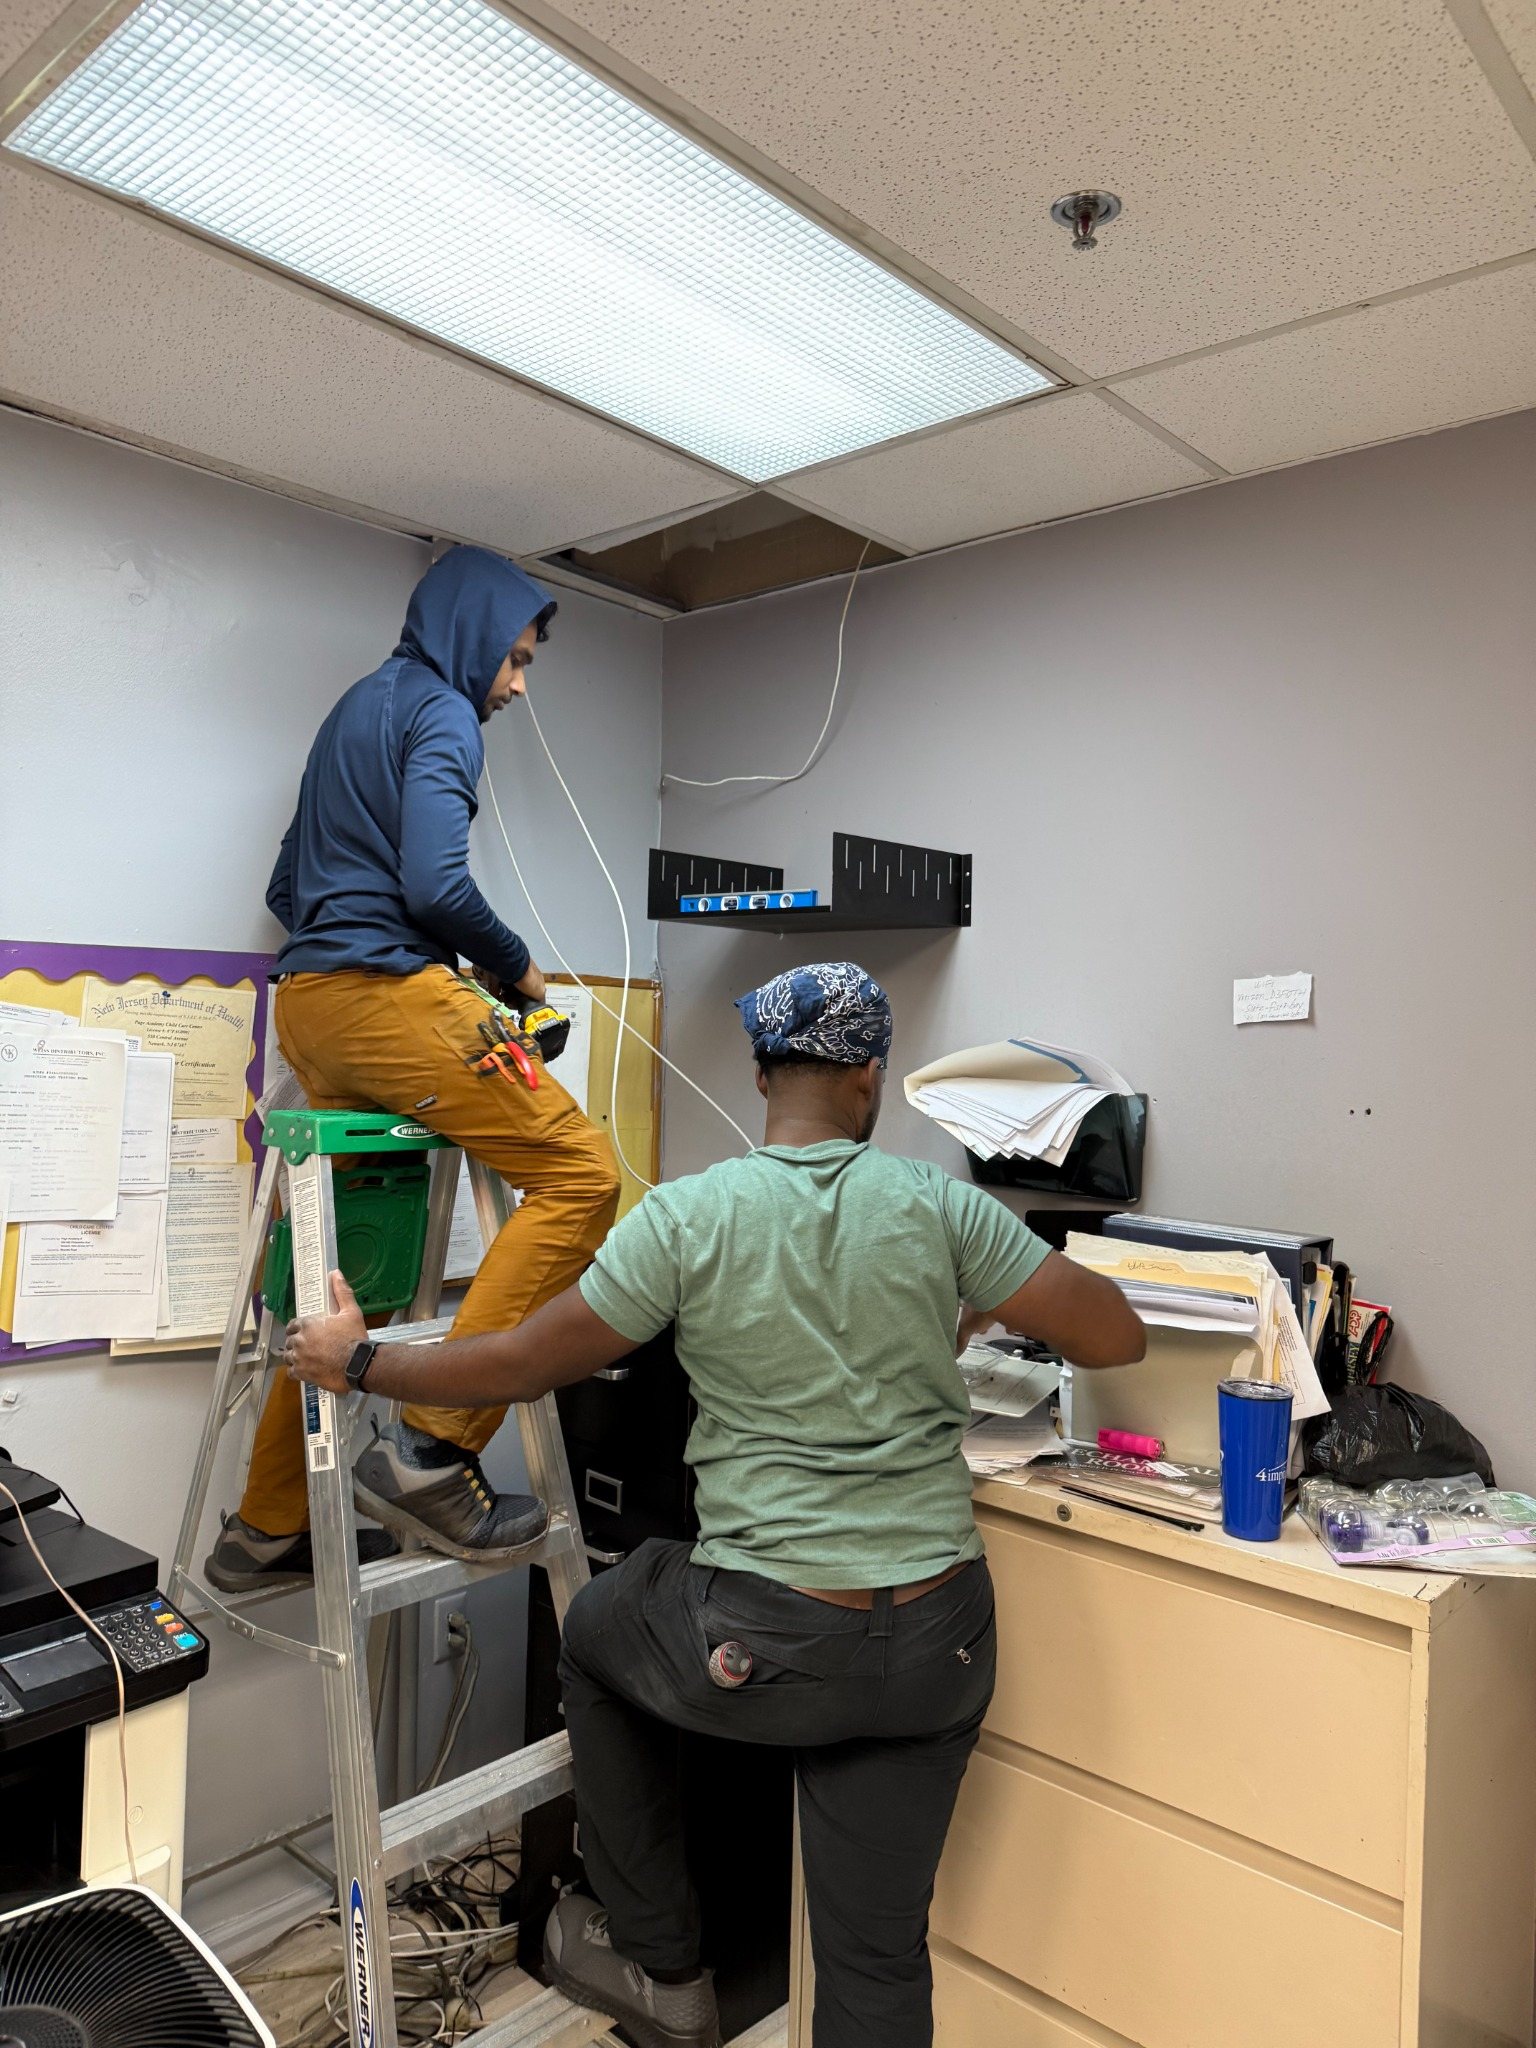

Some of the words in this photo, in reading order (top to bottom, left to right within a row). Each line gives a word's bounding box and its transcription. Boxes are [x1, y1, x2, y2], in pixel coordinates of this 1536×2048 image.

[91, 1001, 115, 1023] New
[118, 997, 148, 1012] Jersey
[152, 993, 204, 1010] Department
[205, 1004, 216, 1014] of
[218, 1005, 245, 1031] Health
[181, 1060, 216, 1068] Certification
[1349, 1310, 1361, 1338] ADP
[354, 1922, 371, 2038] WERNER
